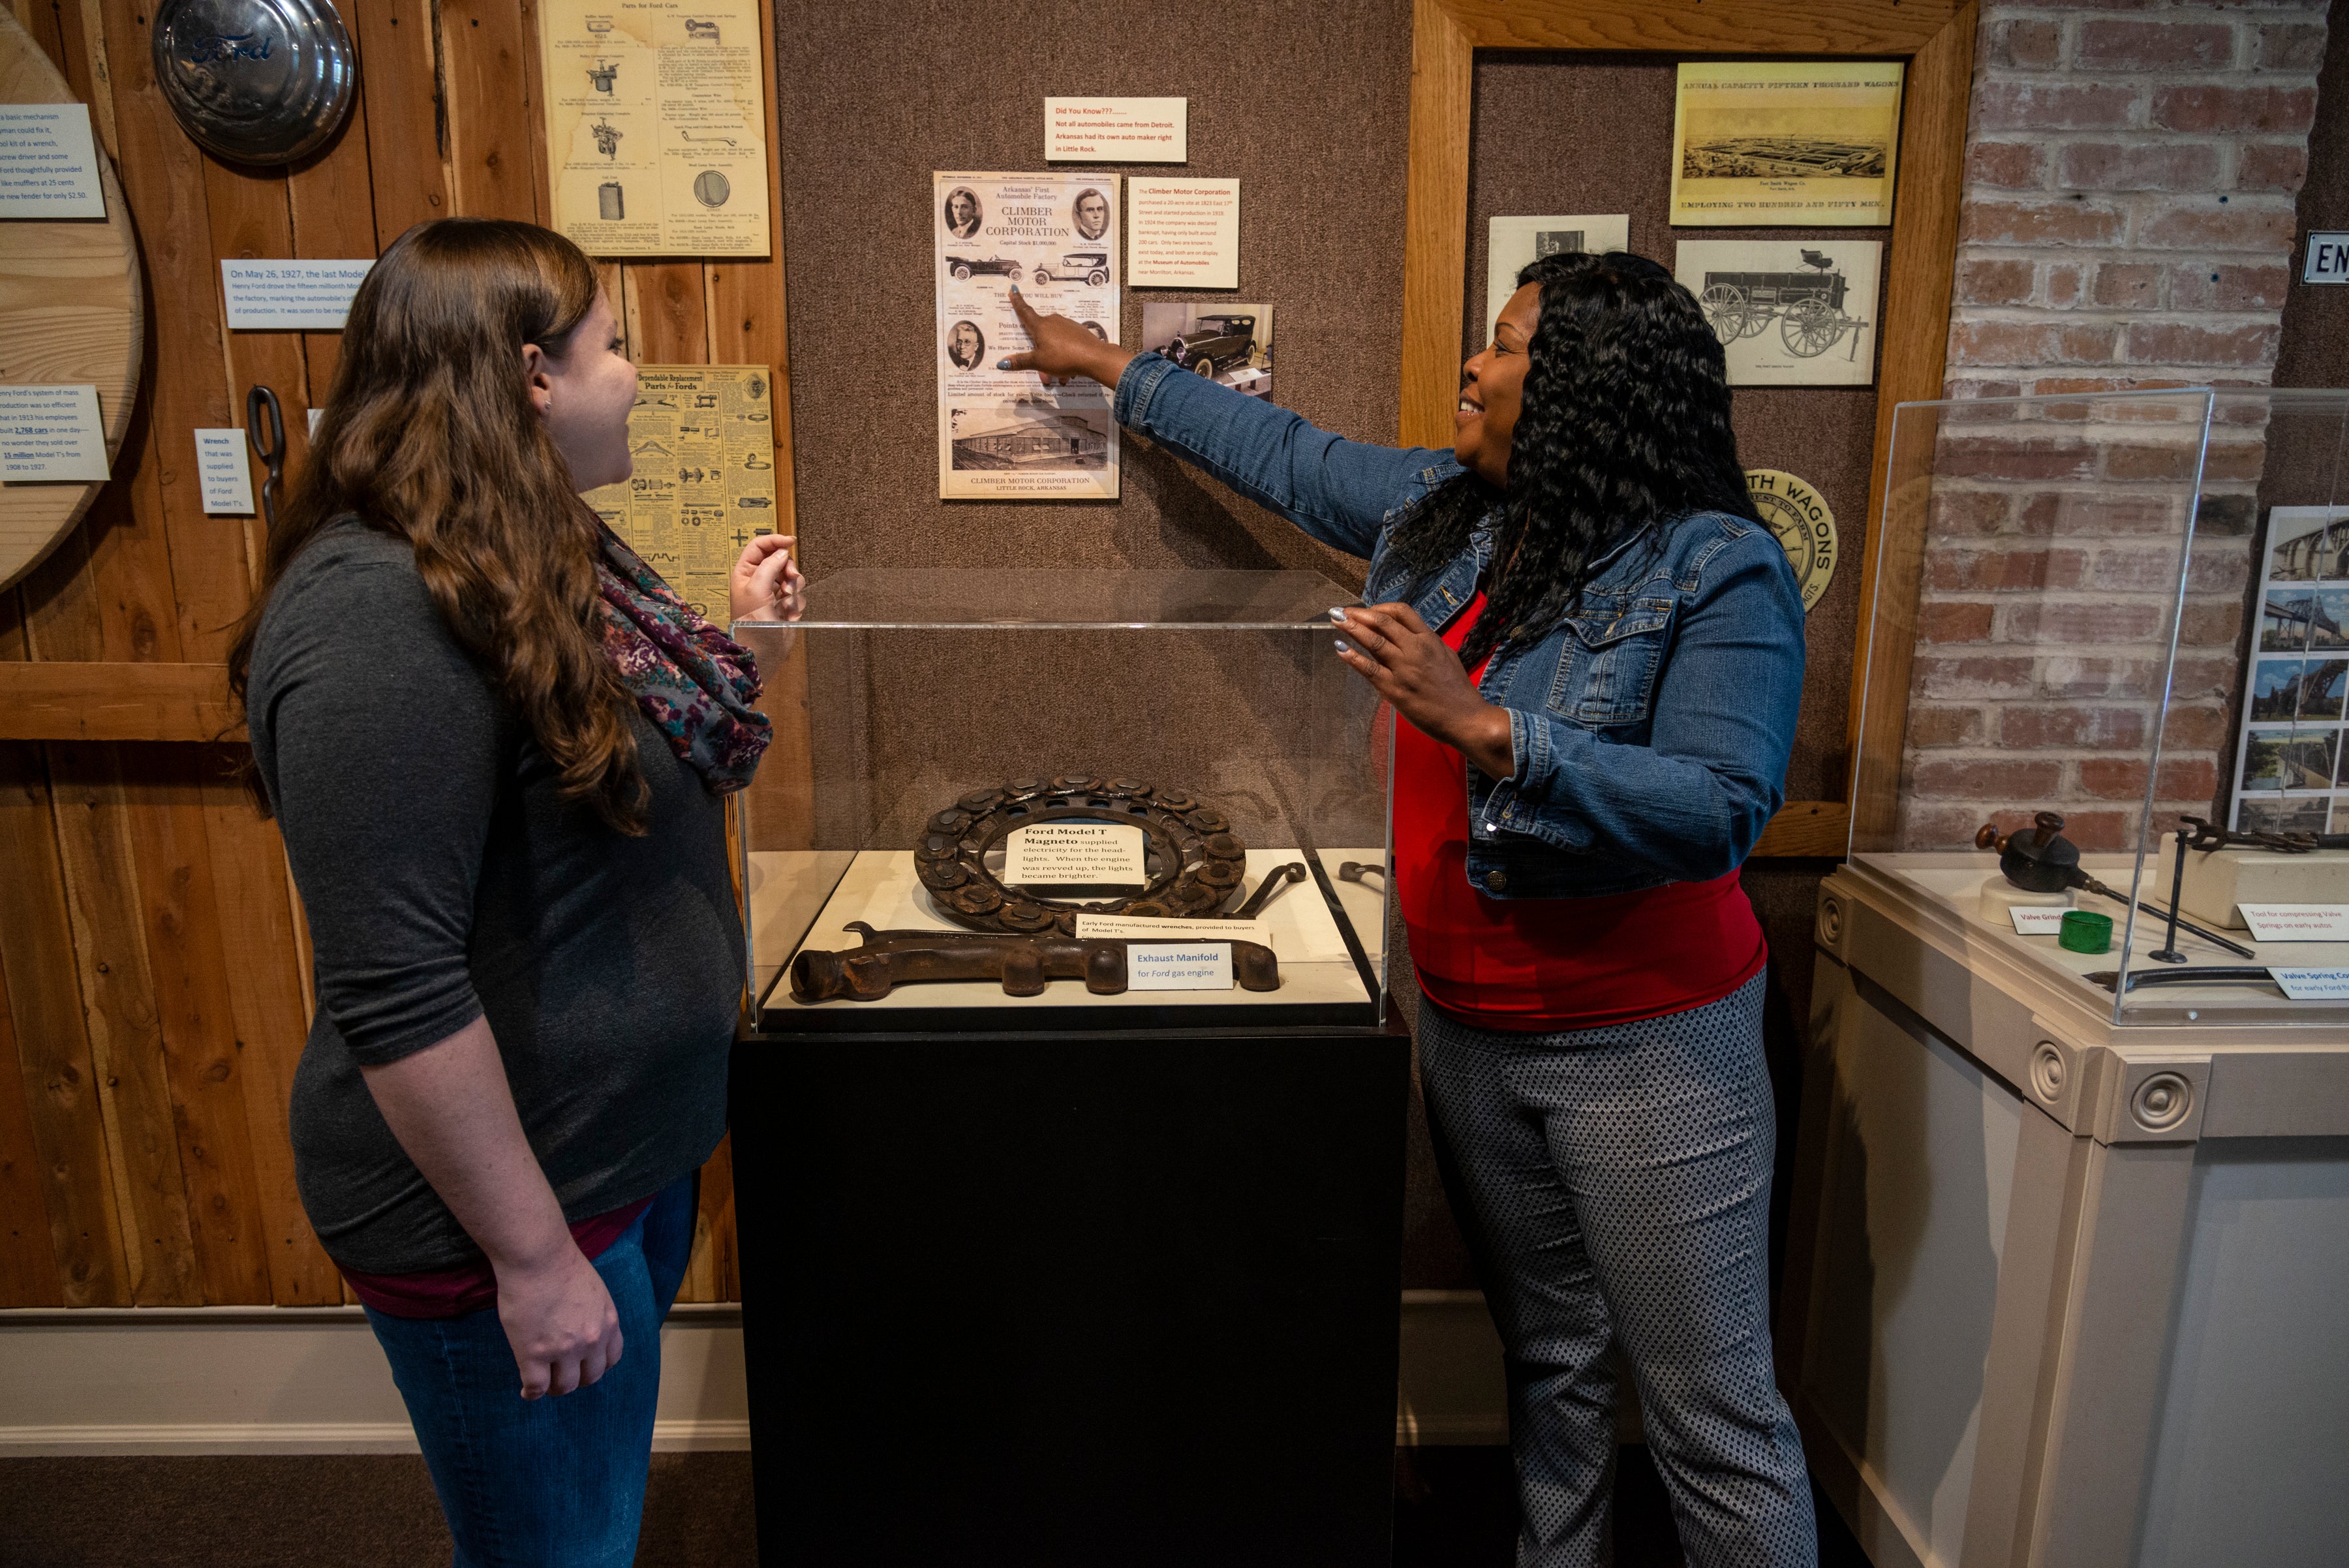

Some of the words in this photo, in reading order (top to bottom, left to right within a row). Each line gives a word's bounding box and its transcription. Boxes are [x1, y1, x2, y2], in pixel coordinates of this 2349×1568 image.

[191, 33, 273, 63] Ford
[1002, 207, 1052, 216] CLIMBER
[1008, 217, 1047, 226] MOTOR
[986, 227, 1069, 236] CORPORATION
[245, 271, 262, 279] May
[638, 374, 669, 382] Dependable
[1747, 474, 1775, 489] TH
[1787, 482, 1832, 570] WAGONS
[1778, 500, 1791, 511] TO
[1792, 512, 1809, 540] FARM
[1188, 970, 1214, 978] engine
